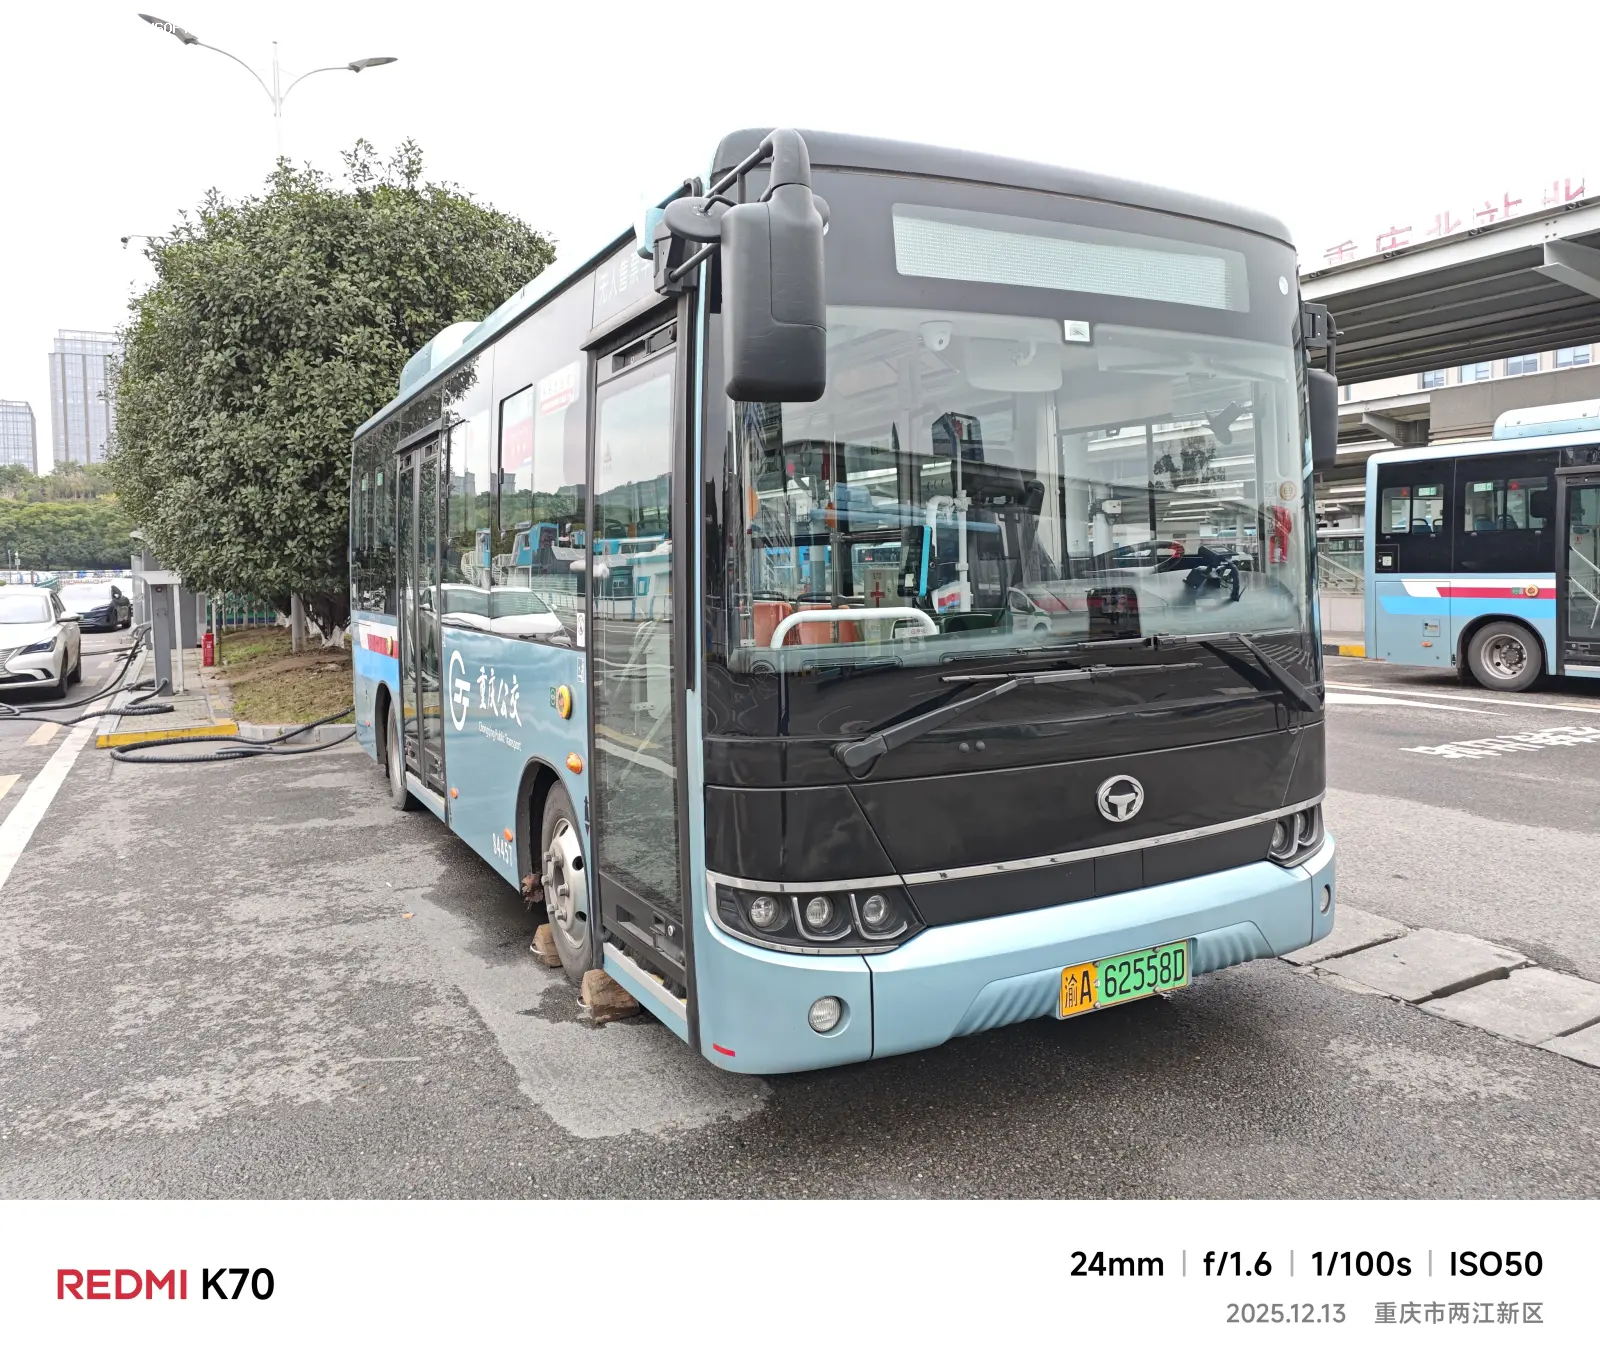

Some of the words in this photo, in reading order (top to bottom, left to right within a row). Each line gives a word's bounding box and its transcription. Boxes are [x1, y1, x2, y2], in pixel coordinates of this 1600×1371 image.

[477, 666, 522, 727] 重庆公交
[492, 832, 513, 867] 84457
